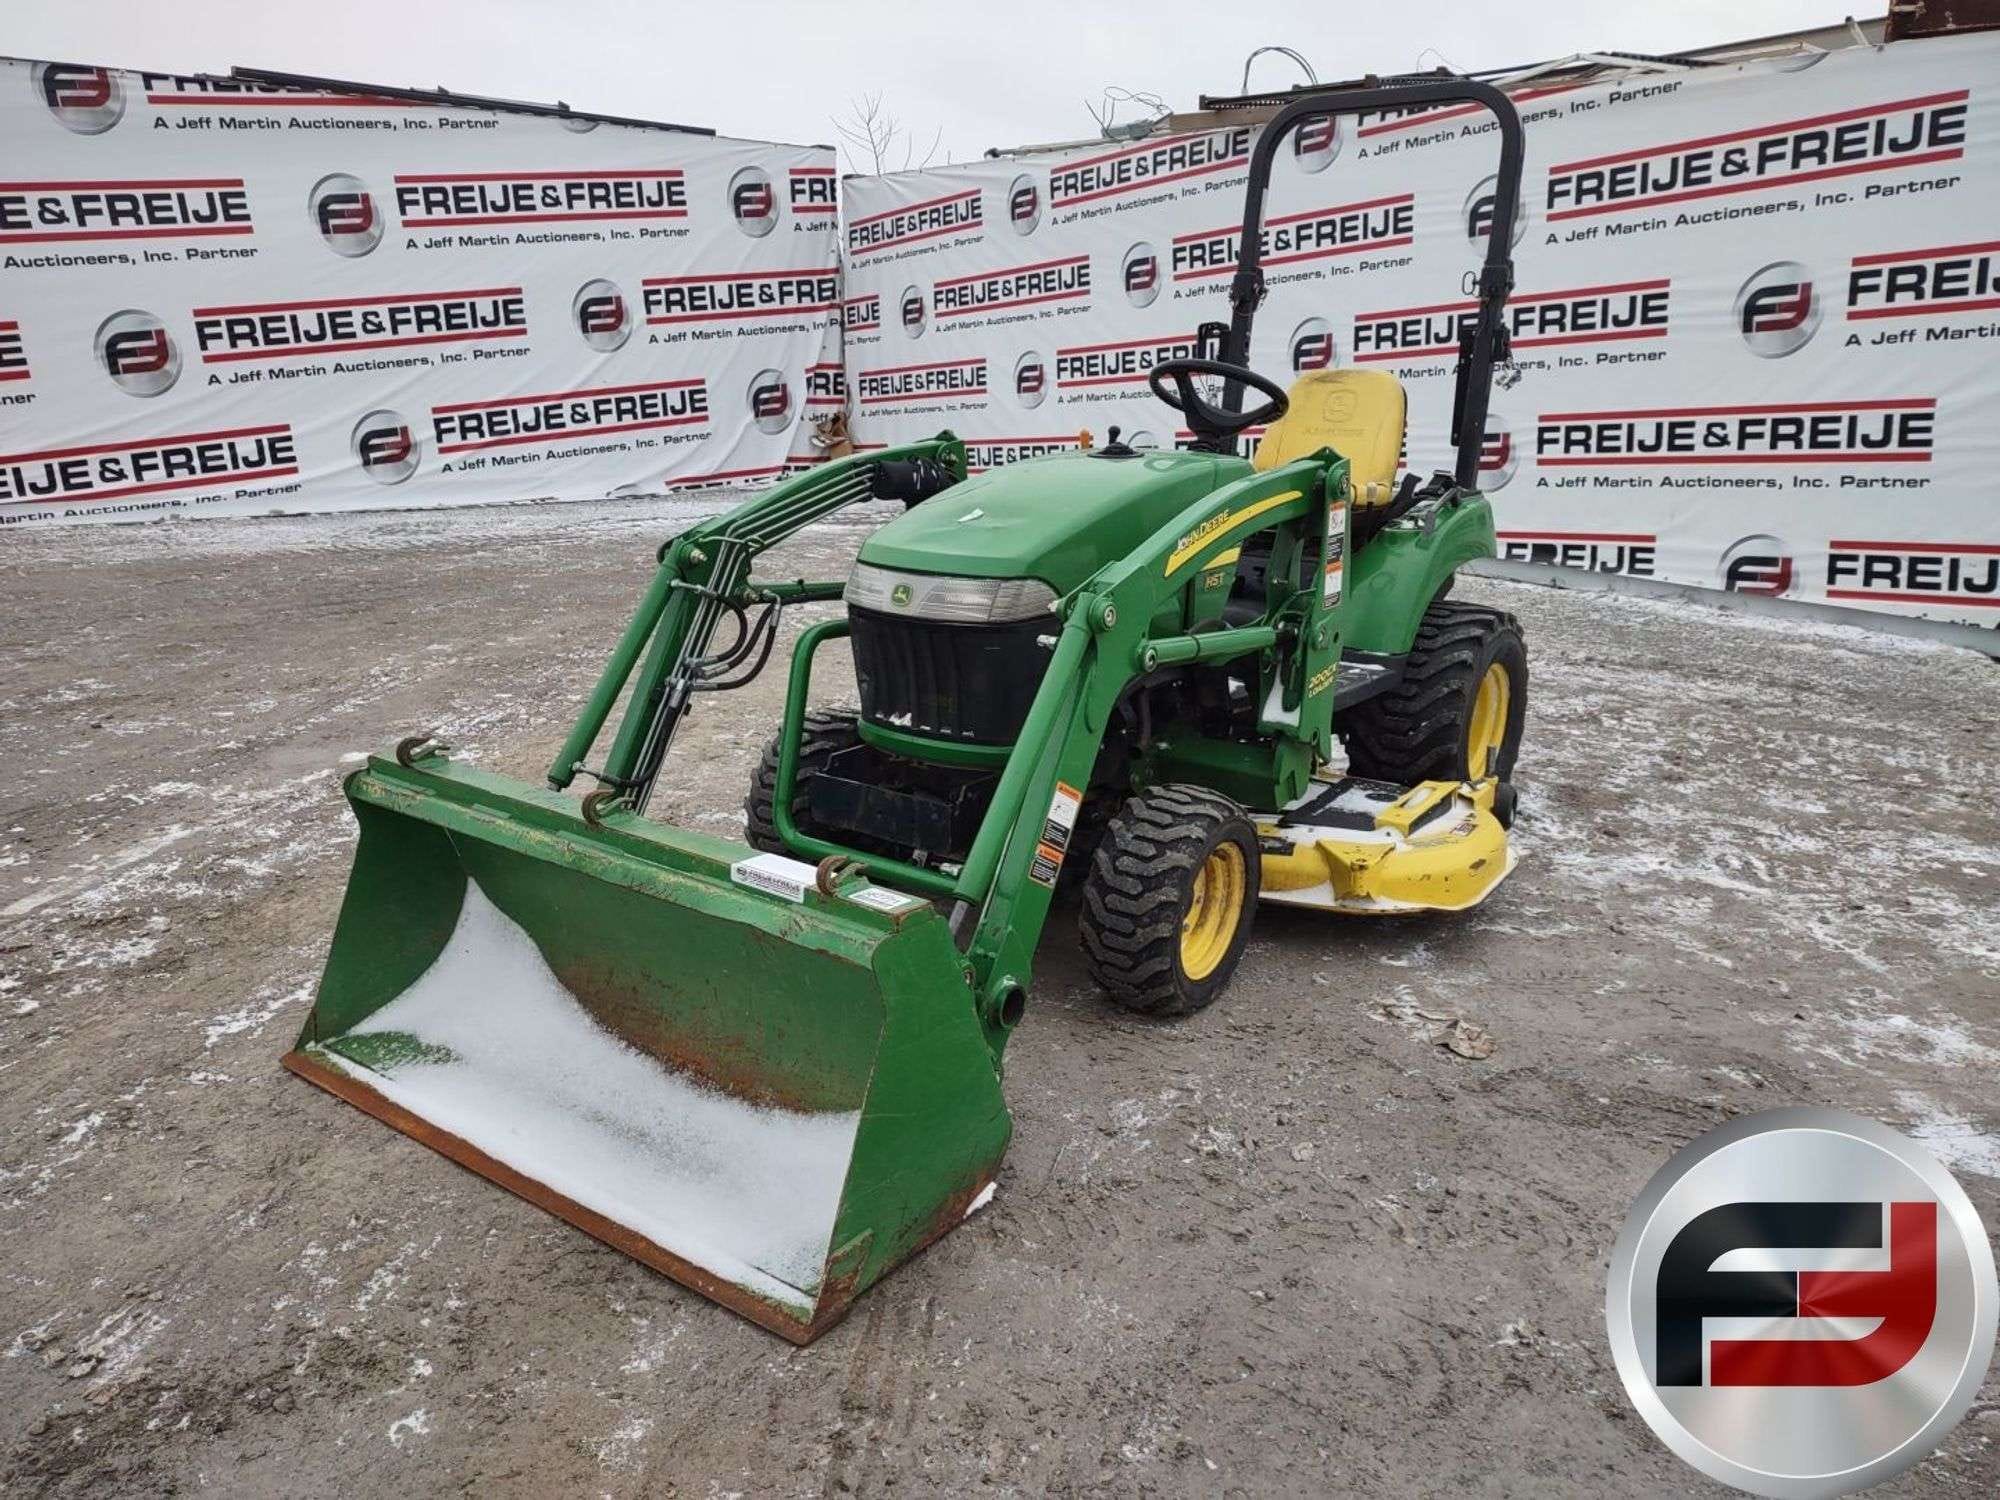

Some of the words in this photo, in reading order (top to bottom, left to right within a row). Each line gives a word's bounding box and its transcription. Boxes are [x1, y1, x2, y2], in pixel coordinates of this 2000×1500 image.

[153, 116, 170, 129] A
[175, 116, 212, 129] Jeff
[218, 117, 281, 130] Martin
[288, 117, 397, 131] Auctioneers,
[403, 118, 432, 129] Inc.
[438, 116, 499, 129] Partner
[1358, 148, 1368, 159] A
[1373, 140, 1400, 156] Jeff
[1405, 132, 1455, 149] Martin
[1570, 100, 1601, 114] Inc.
[1609, 81, 1682, 105] Partner
[1545, 233, 1558, 245] A
[1565, 226, 1599, 242] Jeff
[1605, 218, 1667, 237] Martin
[1674, 200, 1805, 227] Auctioneers,
[1815, 193, 1854, 206] Inc.
[1865, 176, 1961, 199] Partner
[406, 238, 419, 250] A
[424, 236, 453, 249] Jeff
[458, 234, 510, 247] Martin
[515, 232, 605, 244] Auctioneers,
[610, 229, 634, 240] Inc.
[639, 228, 690, 238] Partner
[4, 254, 136, 269] Auctioneers,
[143, 250, 178, 262] Inc.
[185, 248, 258, 260] Partner
[648, 334, 659, 344] A
[663, 332, 687, 343] Jeff
[691, 328, 733, 340] Martin
[737, 324, 810, 336] Auctioneers,
[1845, 334, 1862, 347] A
[1871, 329, 1917, 345] Jeff
[208, 374, 222, 386] A
[228, 370, 262, 384] Jeff
[268, 365, 326, 380] Martin
[333, 357, 434, 374] Auctioneers,
[440, 353, 467, 363] Inc.
[473, 348, 530, 360] Partner
[1400, 366, 1446, 379] Martin
[1559, 356, 1588, 367] Inc.
[1596, 351, 1667, 364] Partner
[441, 463, 454, 473] A
[458, 458, 486, 471] Jeff
[491, 452, 541, 467] Martin
[546, 443, 631, 460] Auctioneers,
[636, 439, 658, 448] Inc.
[663, 432, 712, 445] Partner
[1536, 477, 1549, 488] A
[1555, 476, 1587, 488] Jeff
[1593, 476, 1652, 488] Martin
[1660, 476, 1783, 490] Auctioneers,
[1793, 475, 1830, 488] Inc.
[1840, 475, 1930, 488] Partner
[64, 500, 187, 517] Auctioneers,
[196, 495, 227, 504] Inc.
[235, 484, 302, 499] Partner
[1200, 508, 1230, 539] DEERE
